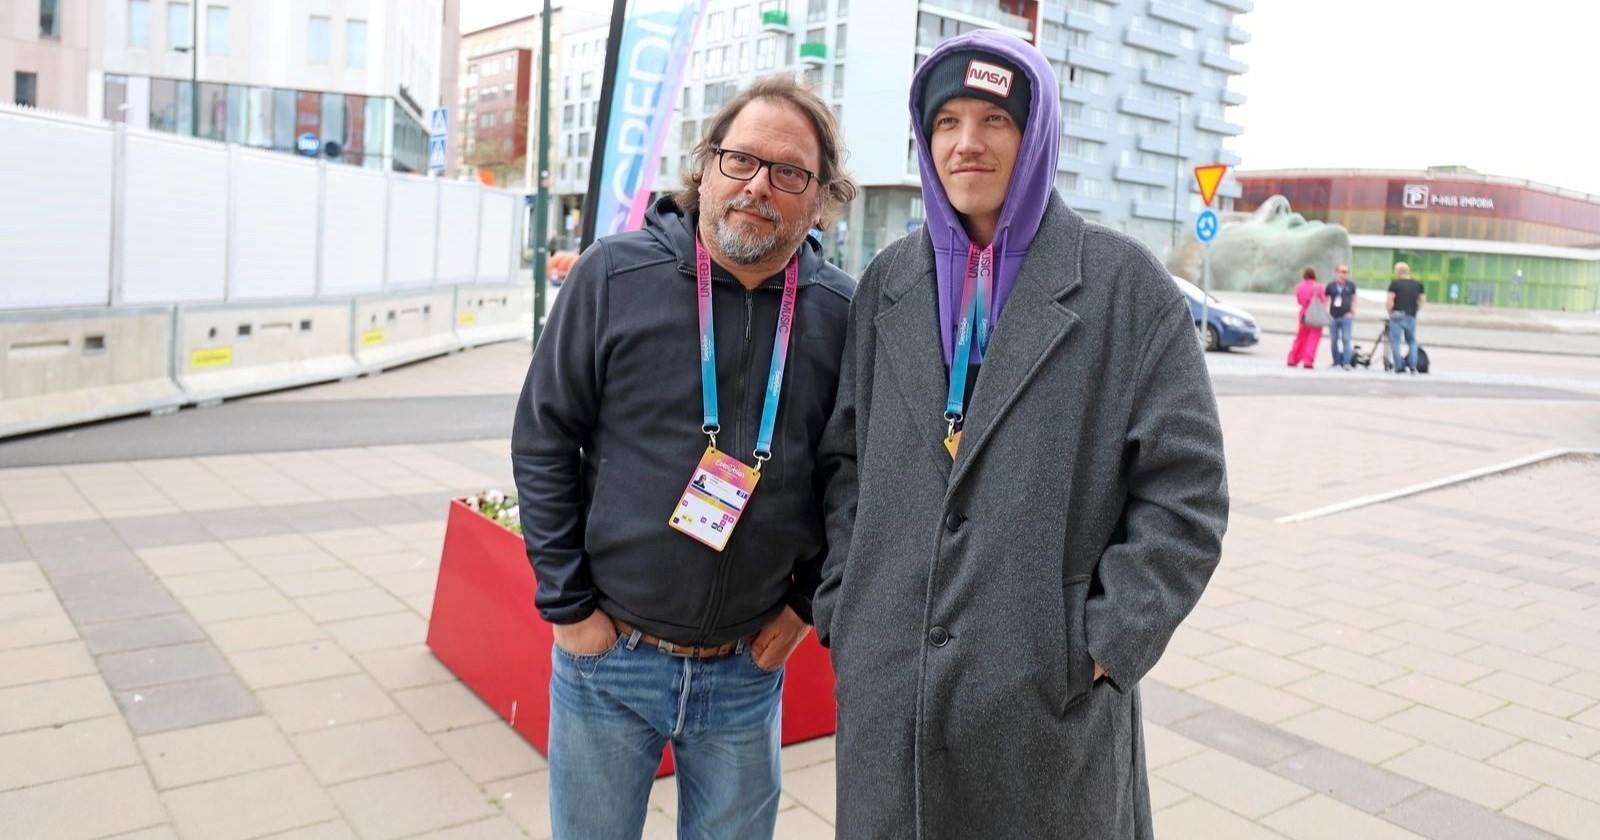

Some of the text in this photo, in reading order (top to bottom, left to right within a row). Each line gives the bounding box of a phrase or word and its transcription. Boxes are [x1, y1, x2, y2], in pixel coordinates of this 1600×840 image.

[969, 68, 1007, 88] NASA
[699, 265, 710, 298] UNITED
[784, 286, 795, 300] BY
[778, 300, 792, 333] MUSIC
